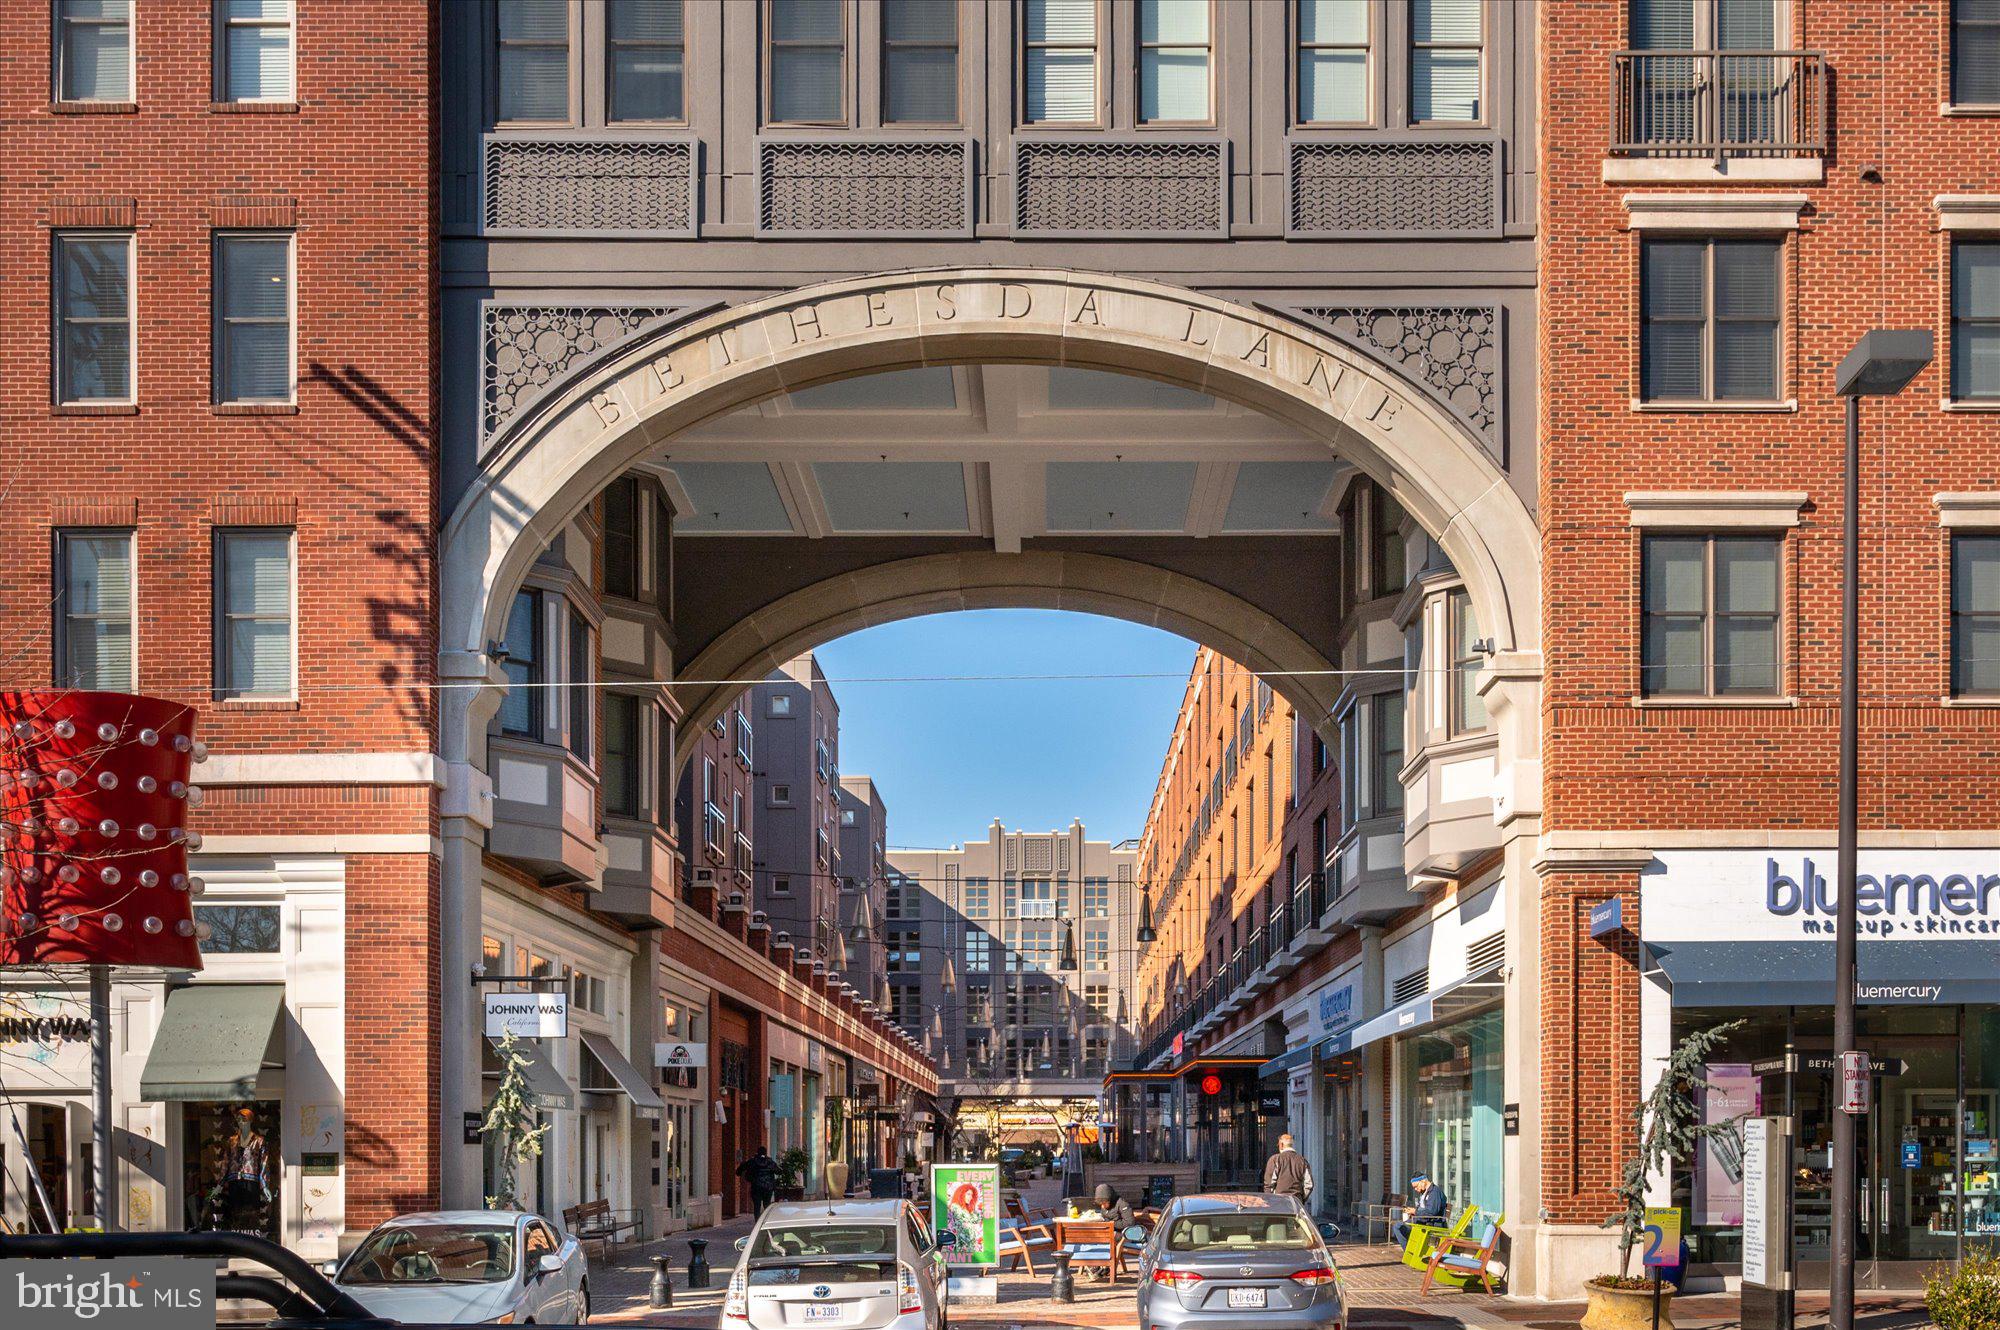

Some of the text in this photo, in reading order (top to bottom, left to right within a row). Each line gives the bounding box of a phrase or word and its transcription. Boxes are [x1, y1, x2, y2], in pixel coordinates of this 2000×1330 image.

[590, 280, 1405, 433] BETHESDA LANE
[1802, 919, 1894, 938] maeup
[1857, 983, 1942, 1001] luemercury
[488, 1005, 564, 1015] JOHNNY WAS
[1854, 1056, 1863, 1068] NO
[956, 1171, 994, 1182] EVERY
[1644, 1225, 1663, 1264] 2
